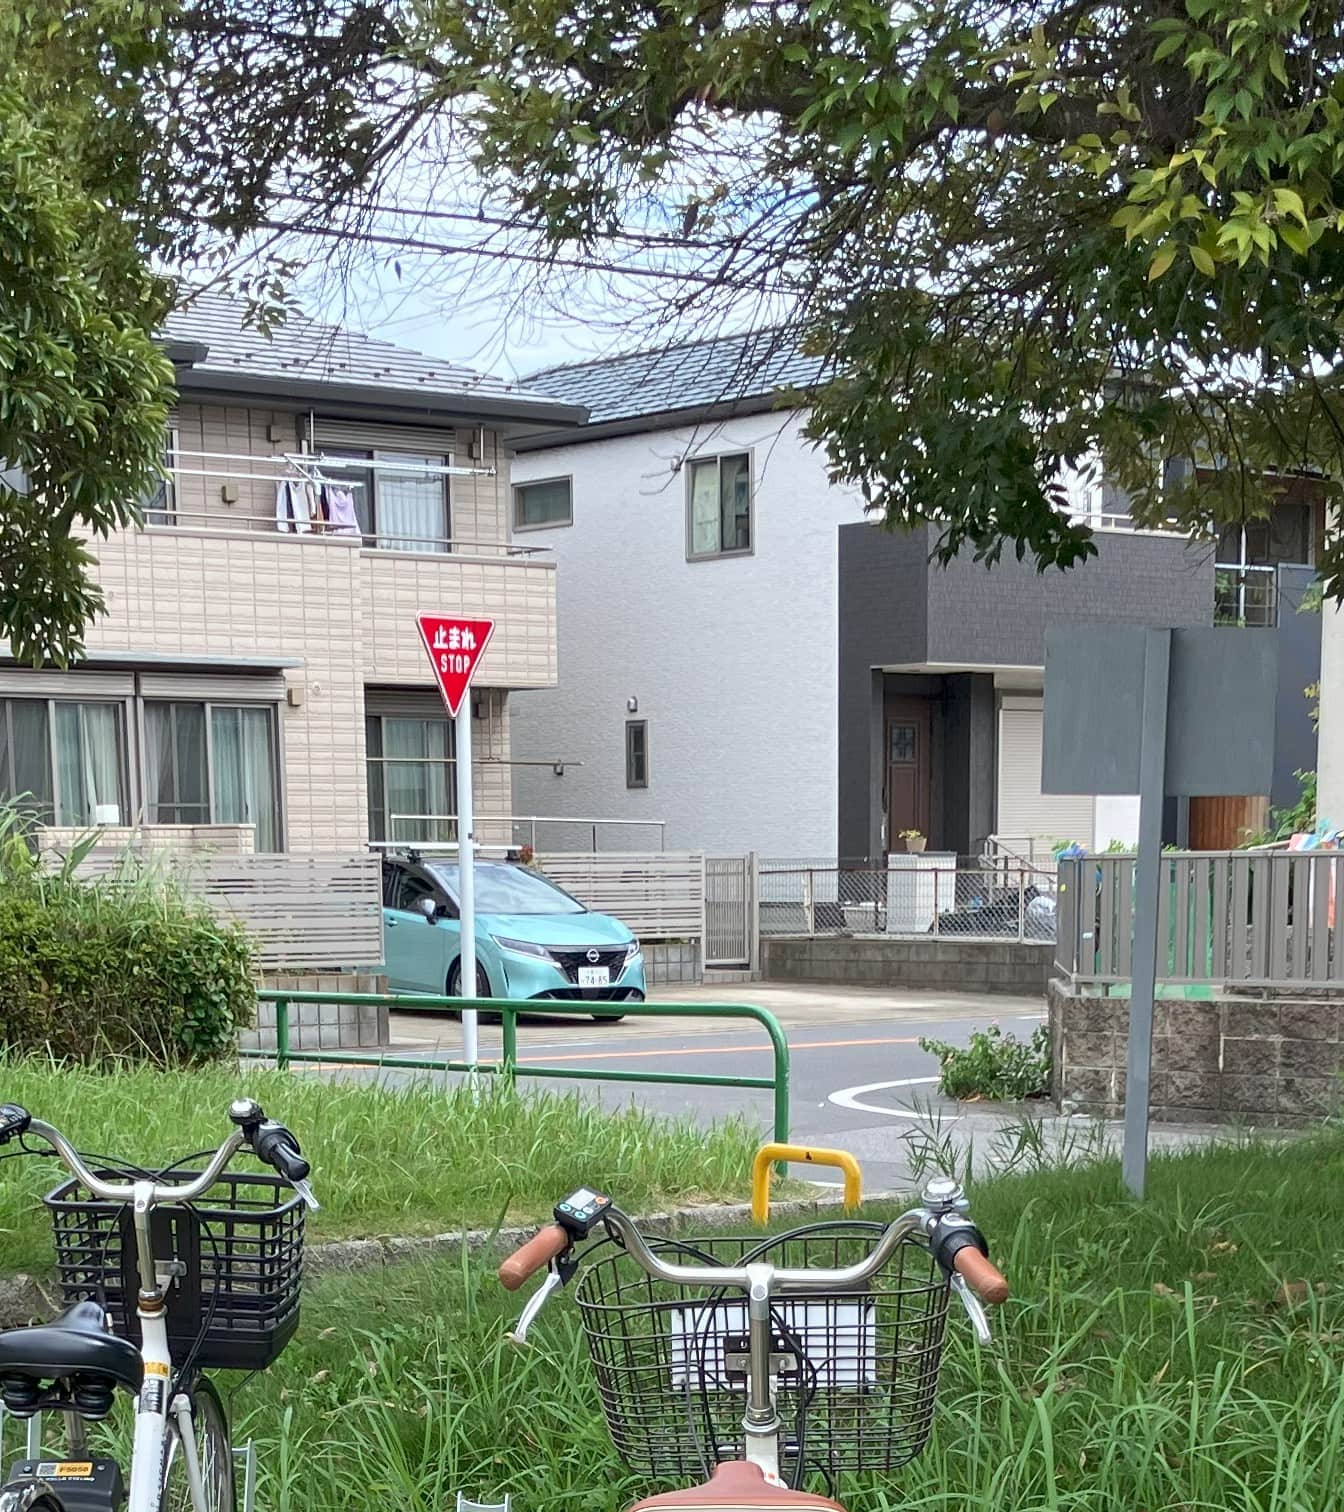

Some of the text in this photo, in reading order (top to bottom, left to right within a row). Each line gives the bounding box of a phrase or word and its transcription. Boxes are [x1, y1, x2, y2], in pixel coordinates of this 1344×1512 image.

[433, 625, 477, 649] 止まれ
[440, 653, 471, 674] STOP
